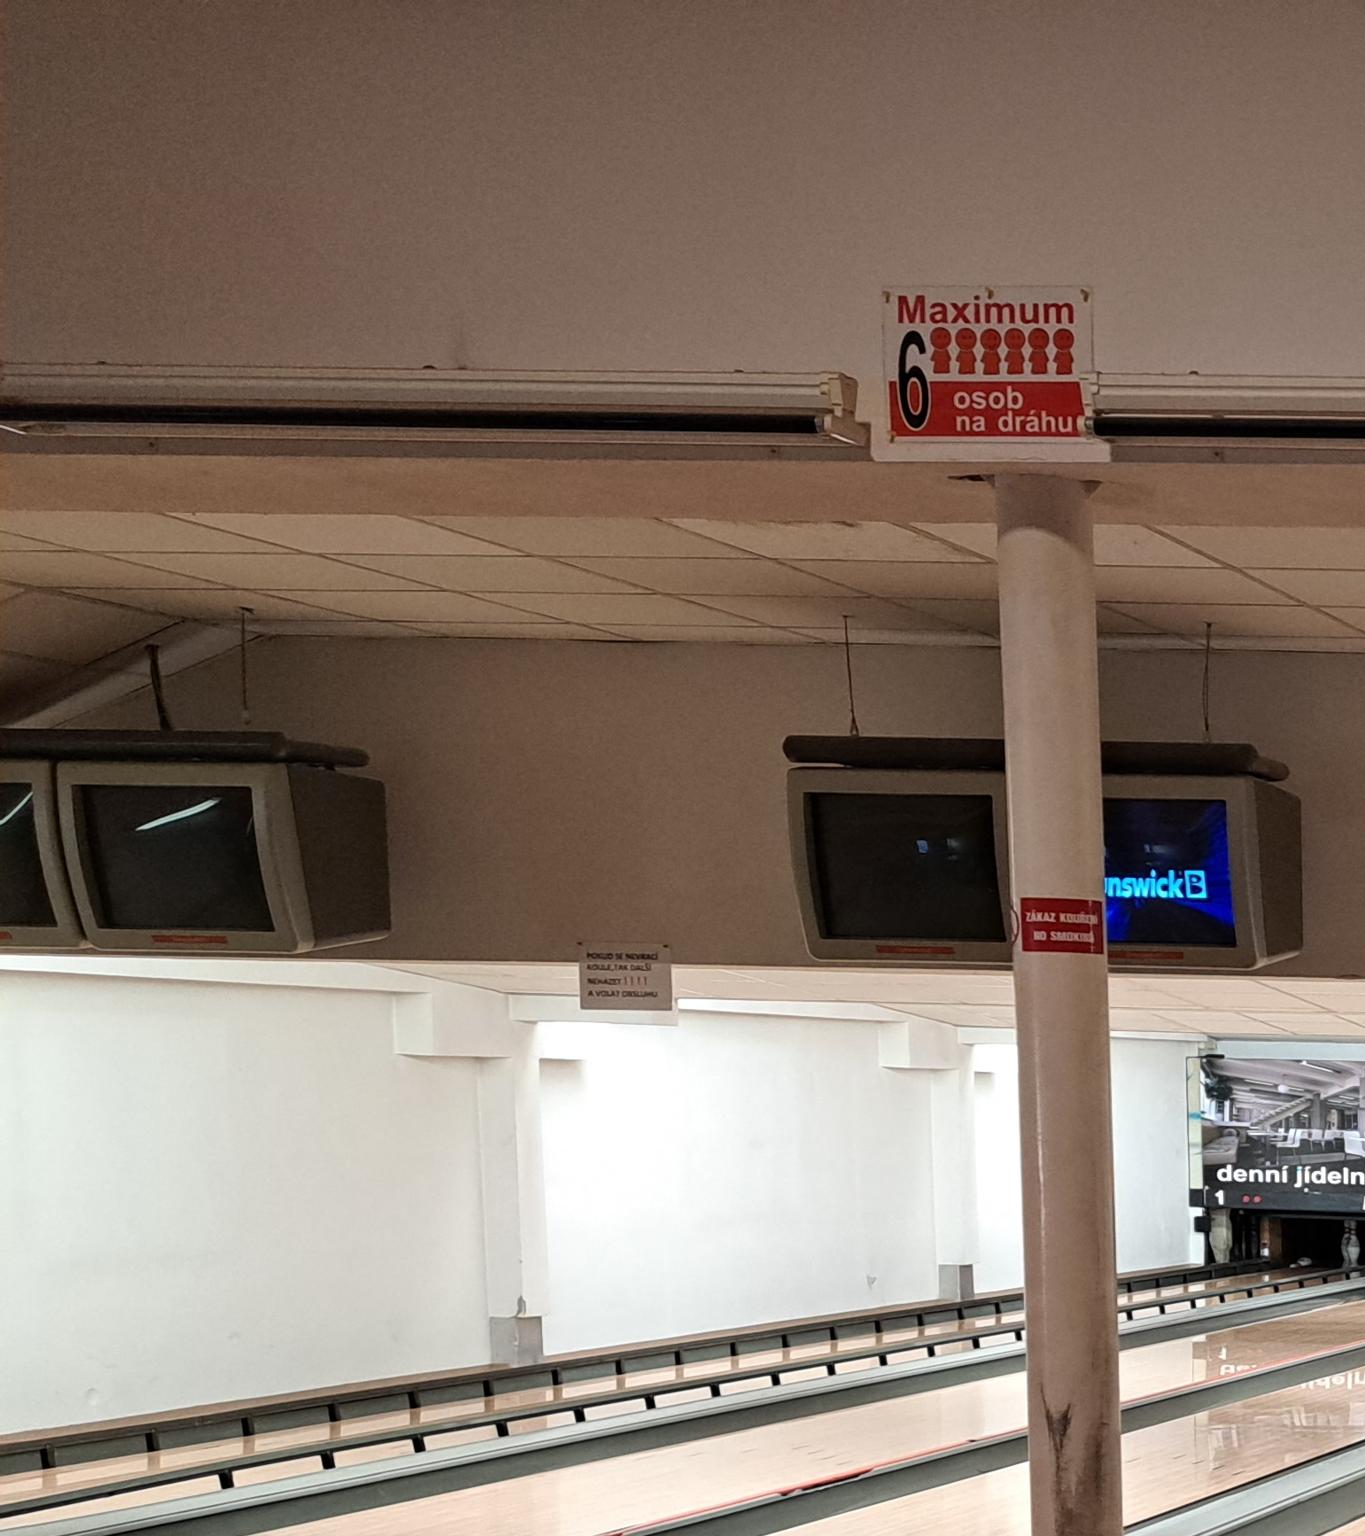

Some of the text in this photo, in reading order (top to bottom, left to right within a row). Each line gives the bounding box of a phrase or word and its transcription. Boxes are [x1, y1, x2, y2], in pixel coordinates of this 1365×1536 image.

[897, 295, 1075, 324] Maximum
[898, 330, 930, 431] 6
[953, 386, 1024, 410] osob
[955, 410, 1073, 433] na dráhu
[1104, 869, 1184, 898] nswick
[1025, 910, 1057, 923] ZÁKAZ
[1216, 1164, 1288, 1184] denní
[1214, 1190, 1224, 1205] 1
